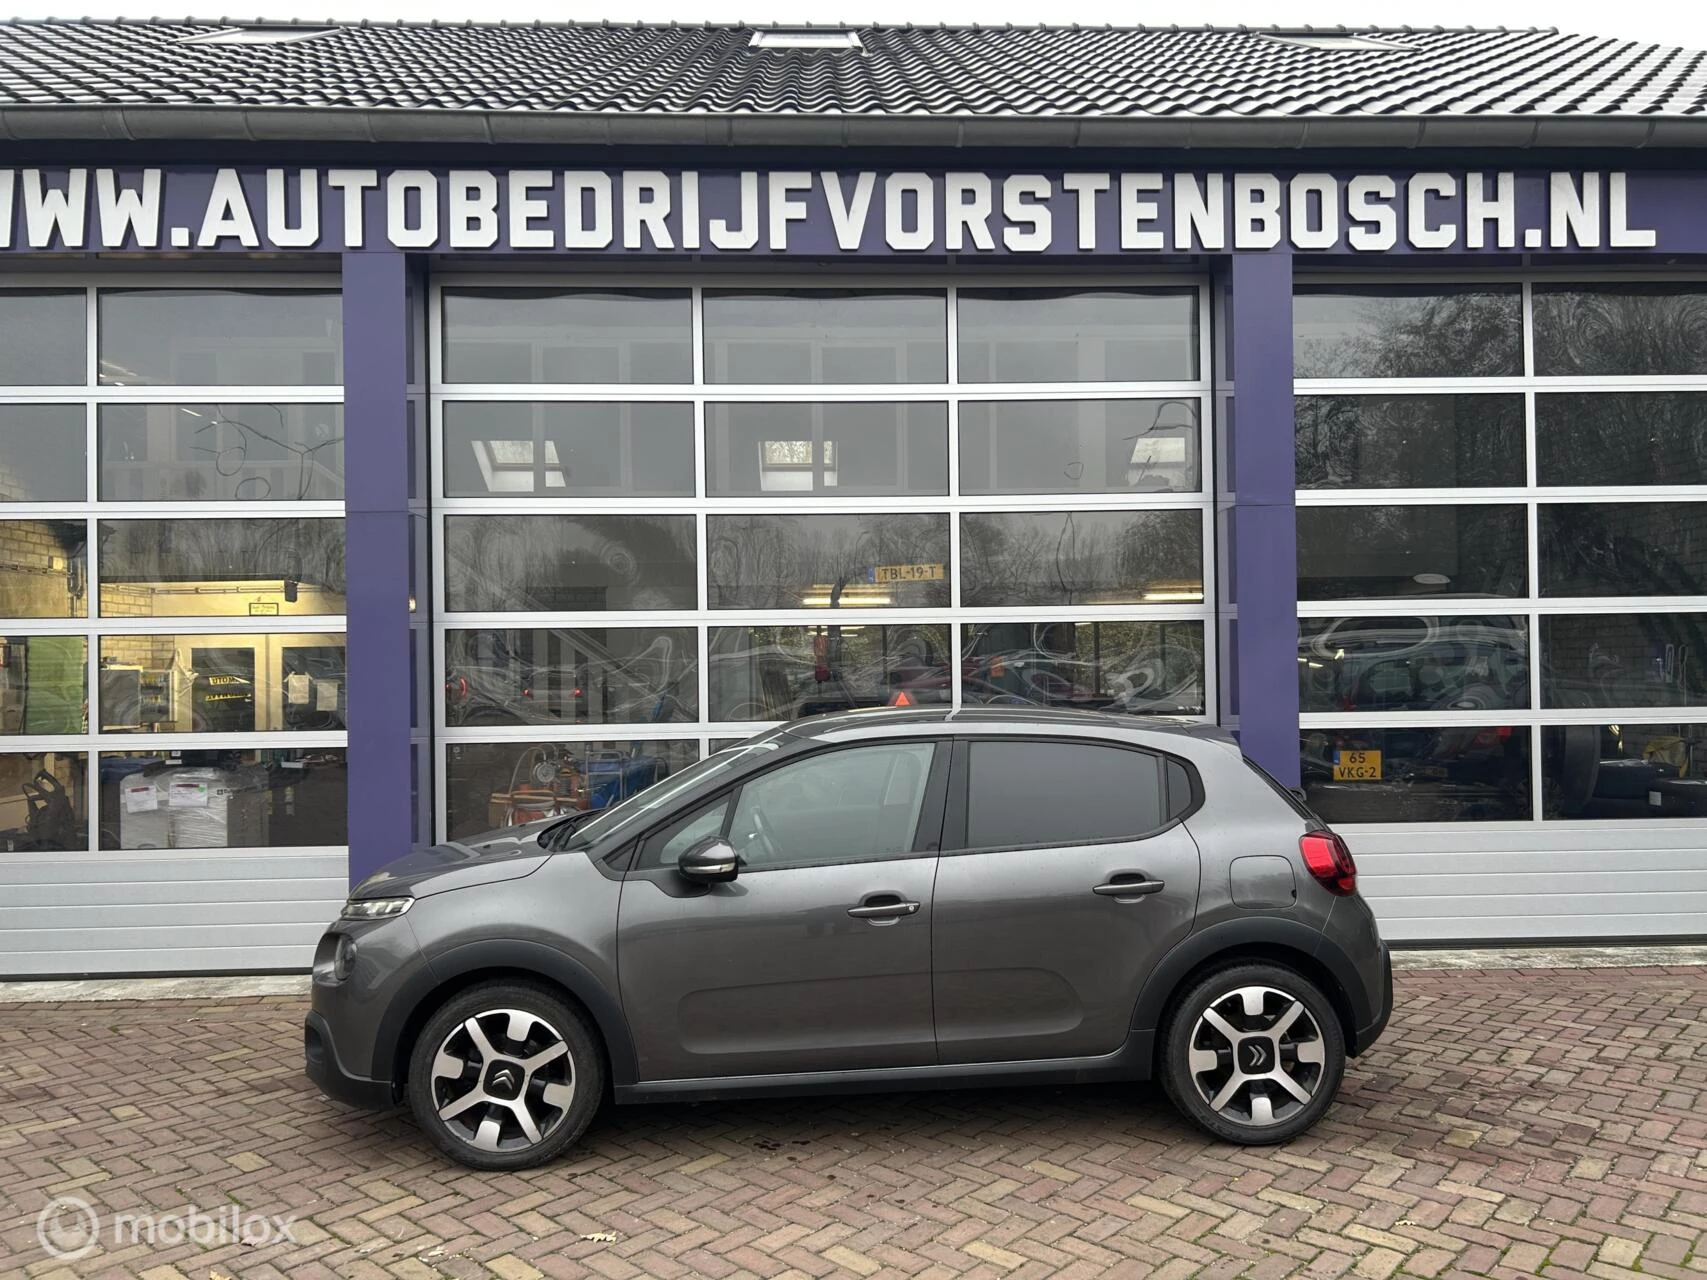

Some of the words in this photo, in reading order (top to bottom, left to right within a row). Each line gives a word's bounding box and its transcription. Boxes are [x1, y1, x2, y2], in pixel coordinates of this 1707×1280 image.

[0, 168, 1656, 252] WW.AUTOBEDRIJFVORSTENBOSCH.NL
[881, 566, 936, 580] TBL-19-T
[1349, 752, 1366, 764] 65
[1339, 766, 1377, 778] VKG-2
